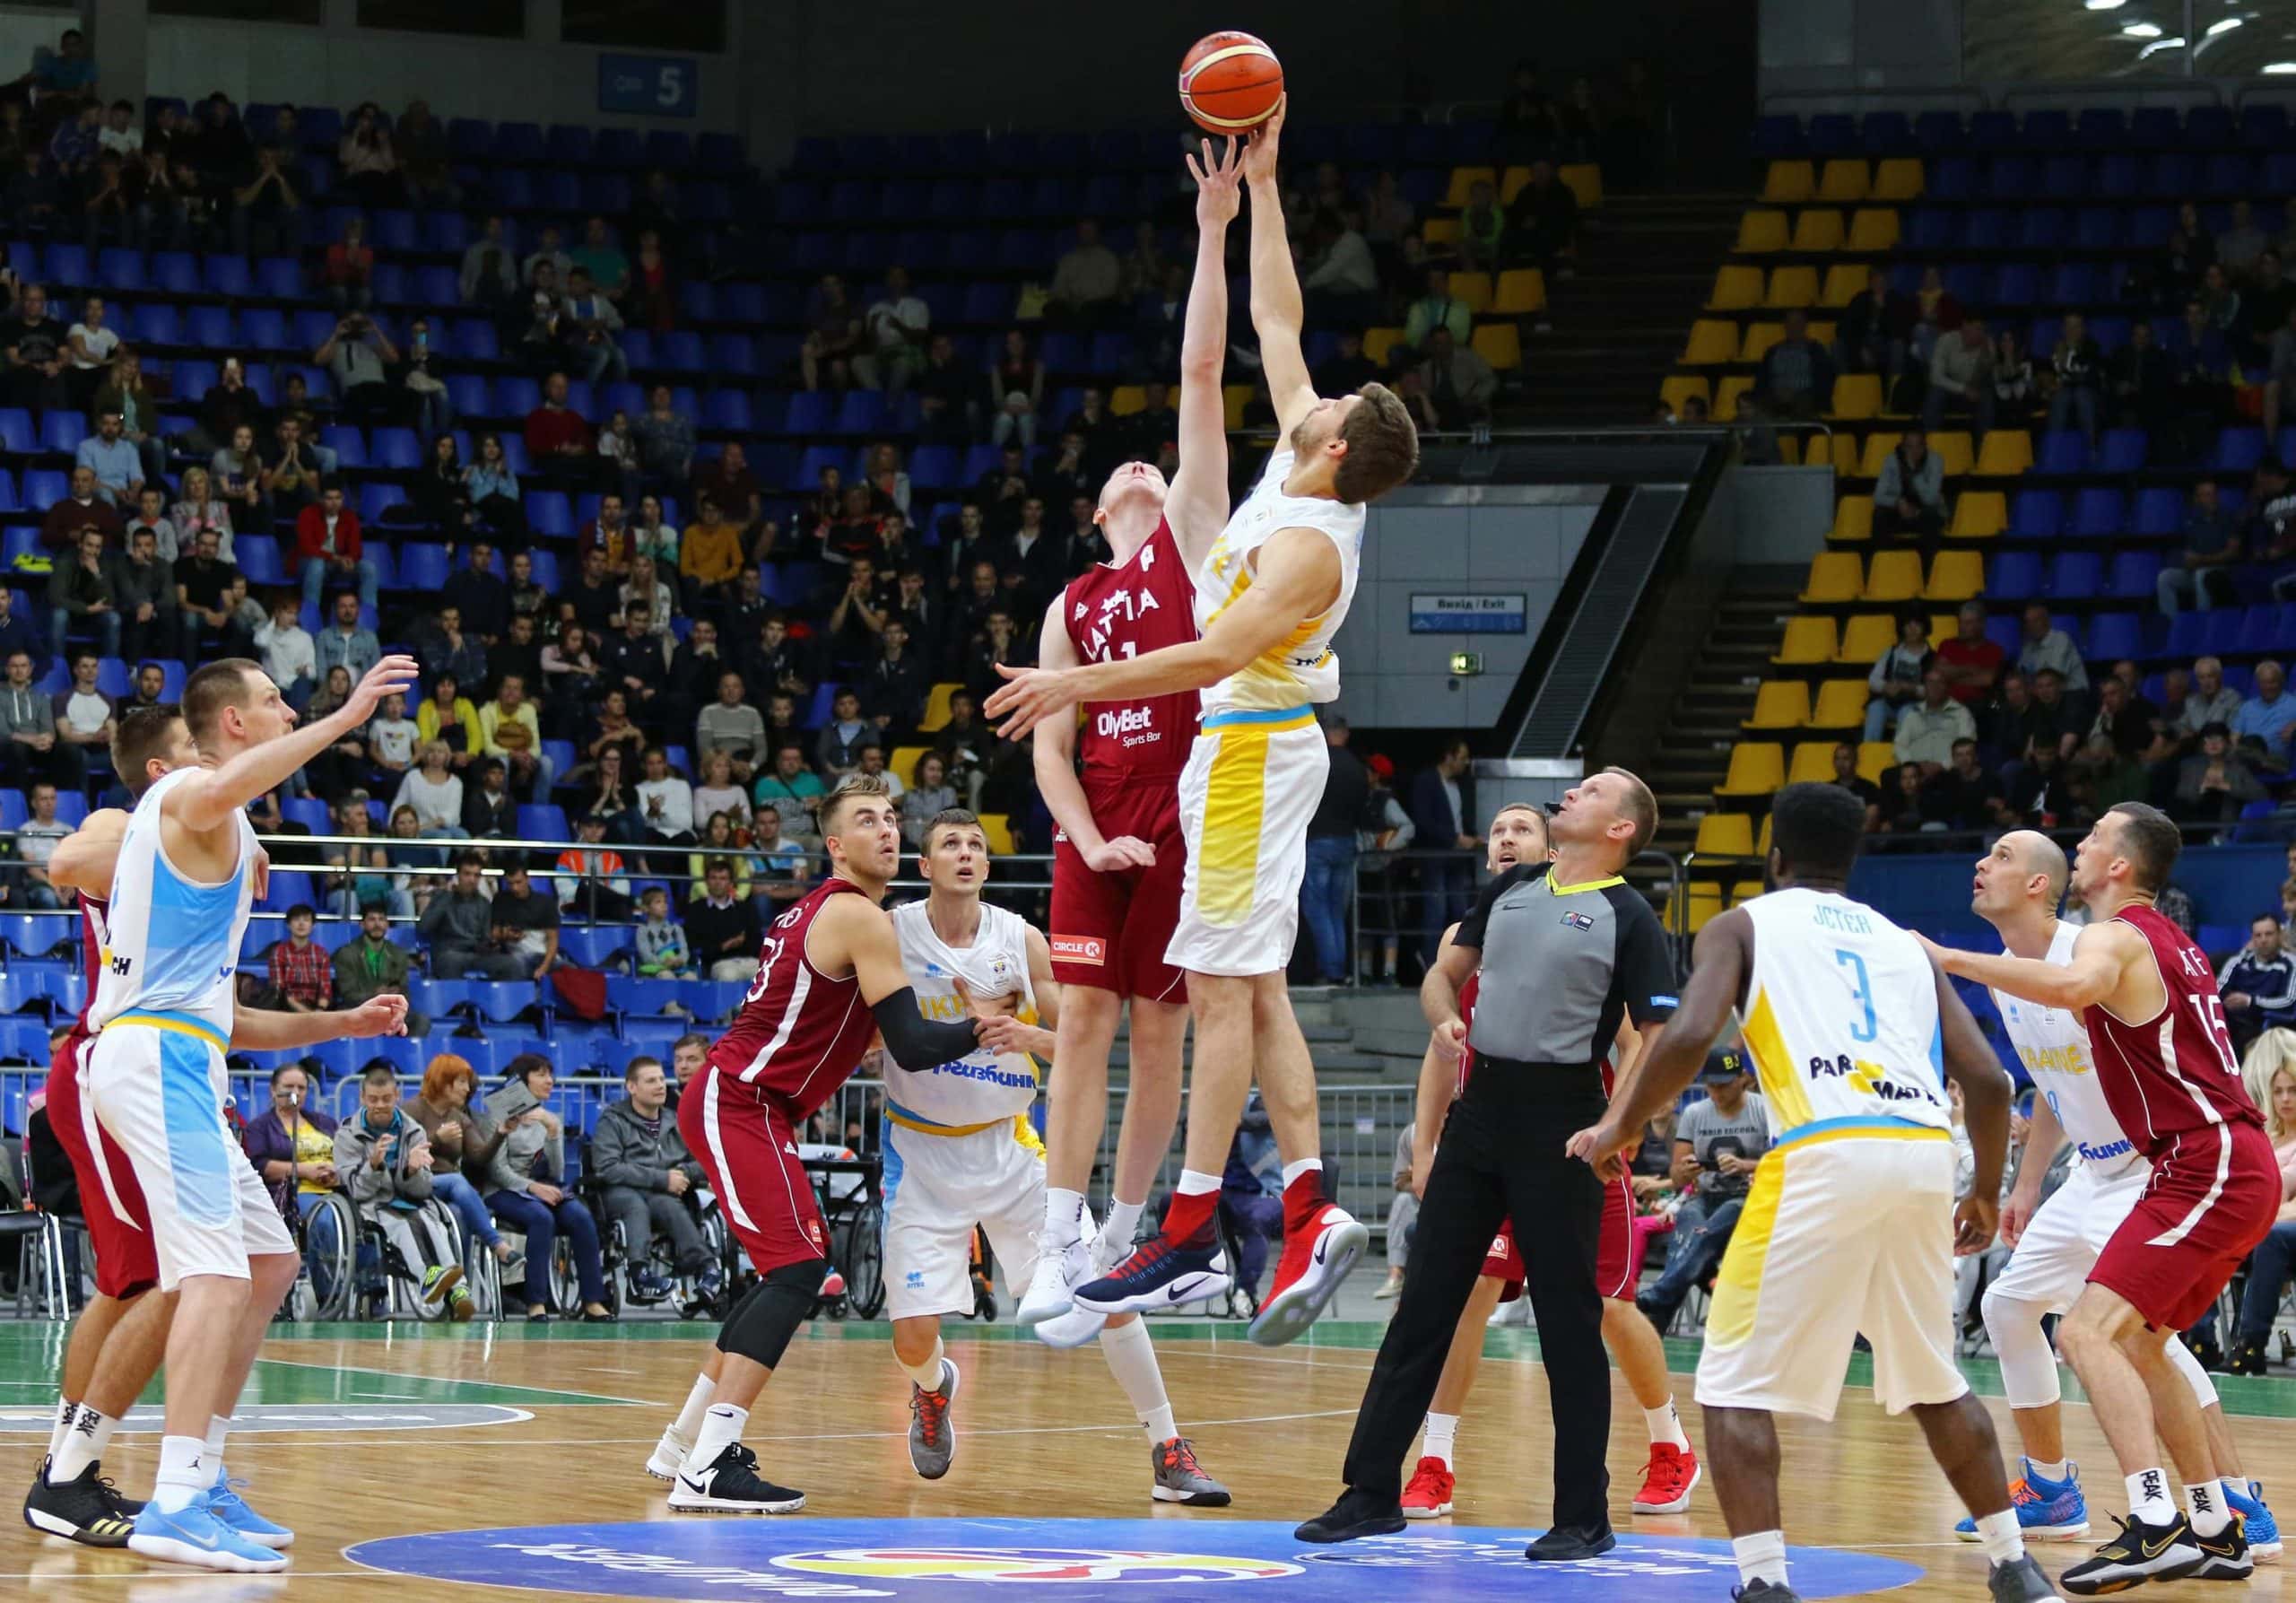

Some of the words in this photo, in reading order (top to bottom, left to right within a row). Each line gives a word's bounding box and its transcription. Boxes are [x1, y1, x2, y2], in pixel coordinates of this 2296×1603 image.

[657, 65, 682, 107] 5
[1082, 588, 1161, 661] LATIA
[1098, 706, 1152, 739] OlyBet
[1122, 735, 1145, 748] Sports
[1146, 732, 1161, 743] Bar
[1053, 941, 1084, 953] CIRCLE
[1835, 949, 1877, 1042] 3
[2139, 1469, 2163, 1503] PEAK
[2189, 1486, 2213, 1514] PEAK
